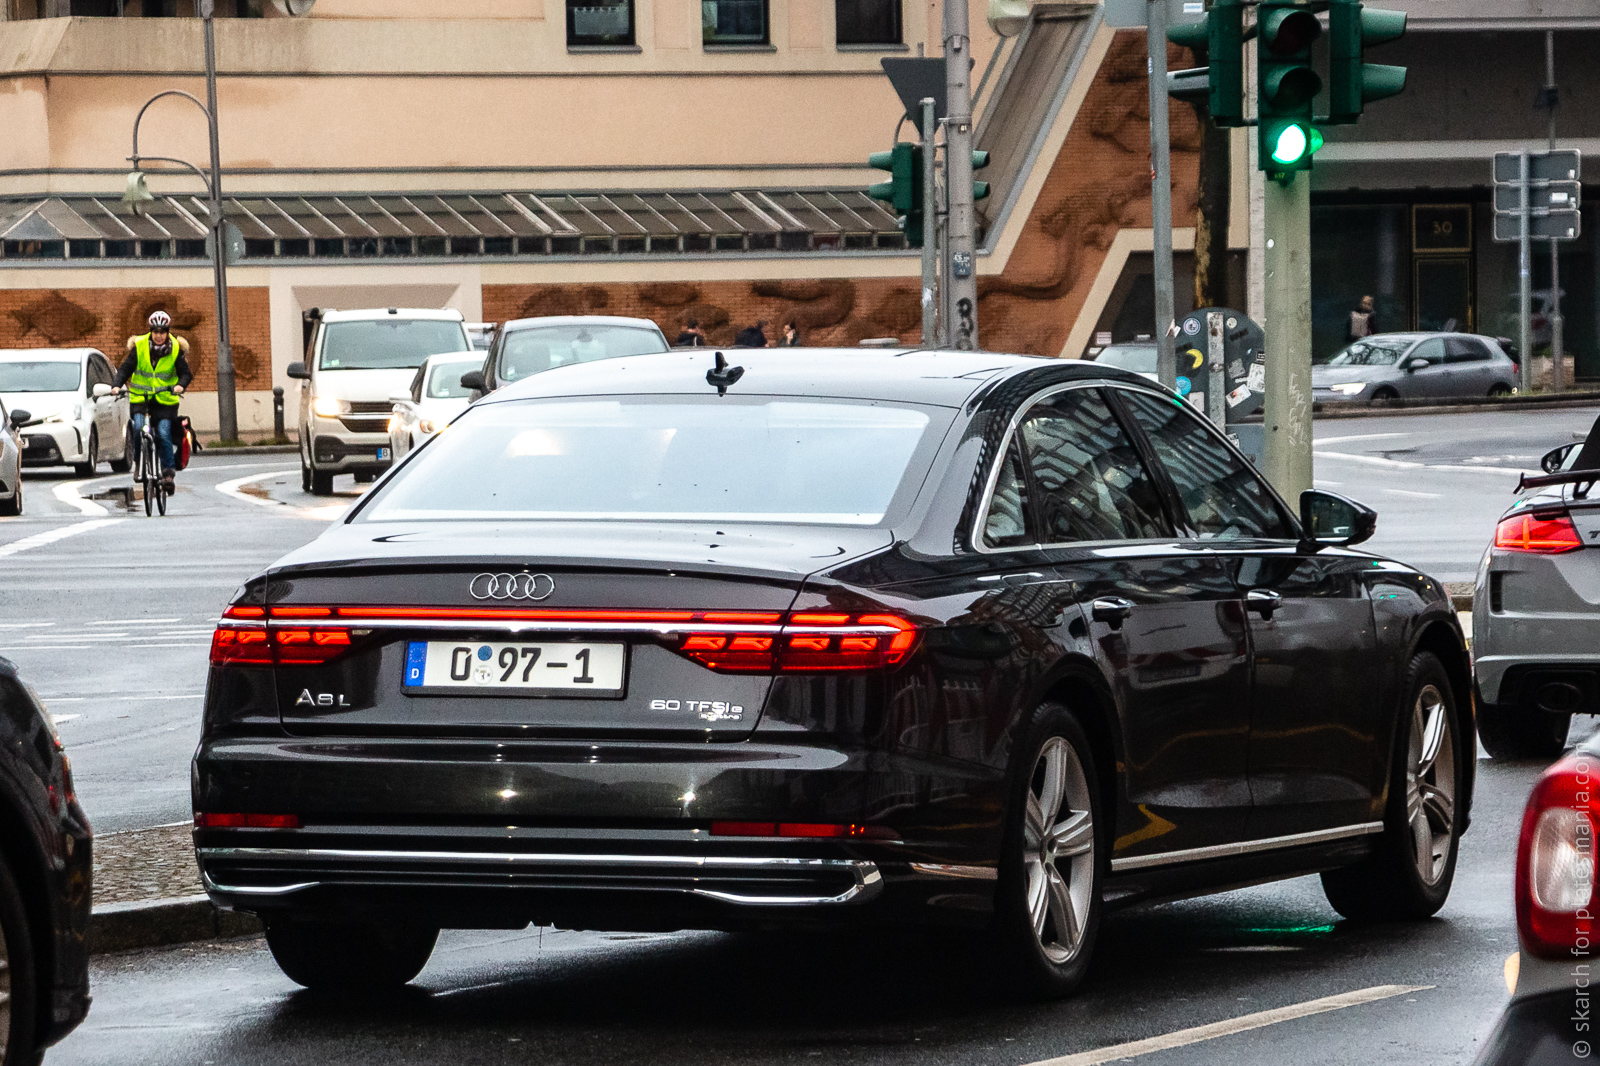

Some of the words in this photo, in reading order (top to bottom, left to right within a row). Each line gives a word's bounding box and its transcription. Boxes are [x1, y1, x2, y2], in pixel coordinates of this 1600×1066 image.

[1433, 221, 1453, 234] 30
[411, 668, 420, 679] D
[651, 699, 681, 711] 60
